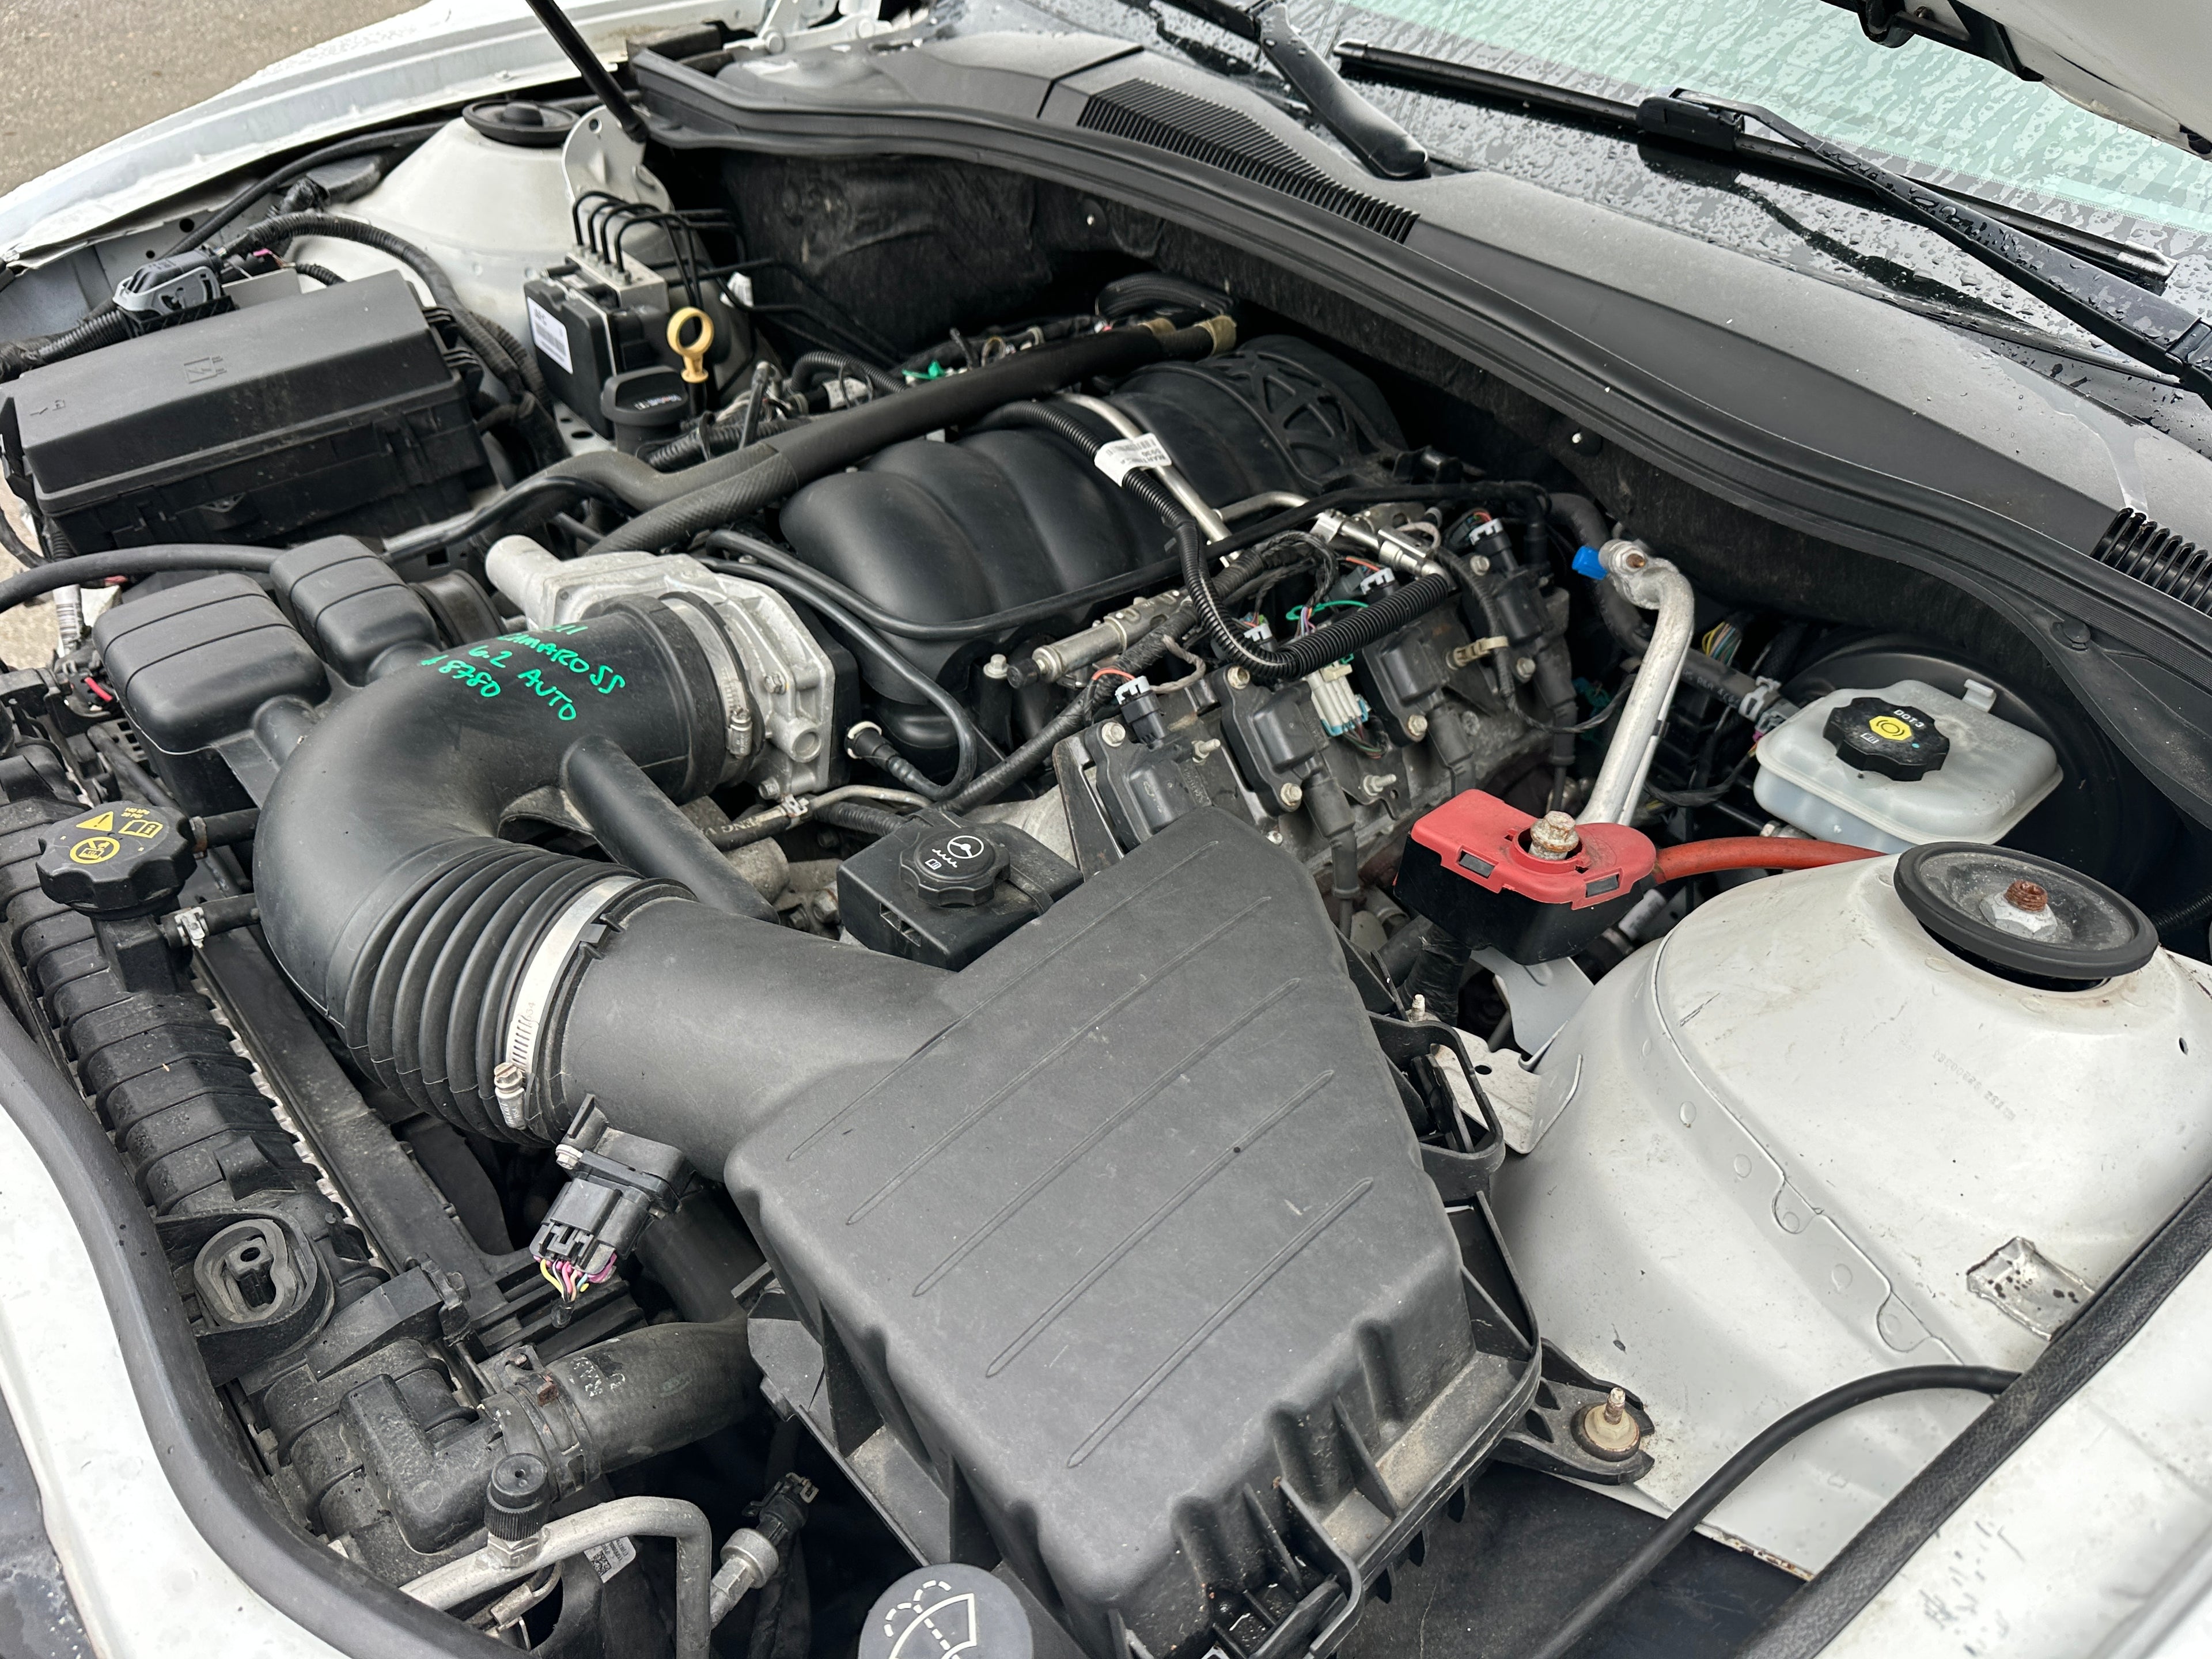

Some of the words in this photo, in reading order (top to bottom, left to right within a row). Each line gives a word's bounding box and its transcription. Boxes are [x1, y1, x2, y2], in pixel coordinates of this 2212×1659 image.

[468, 645, 513, 669] 6.2
[517, 668, 577, 721] AUTO
[498, 633, 590, 673] CAMARO
[589, 664, 626, 695] SS
[1893, 709, 1918, 724] DOT
